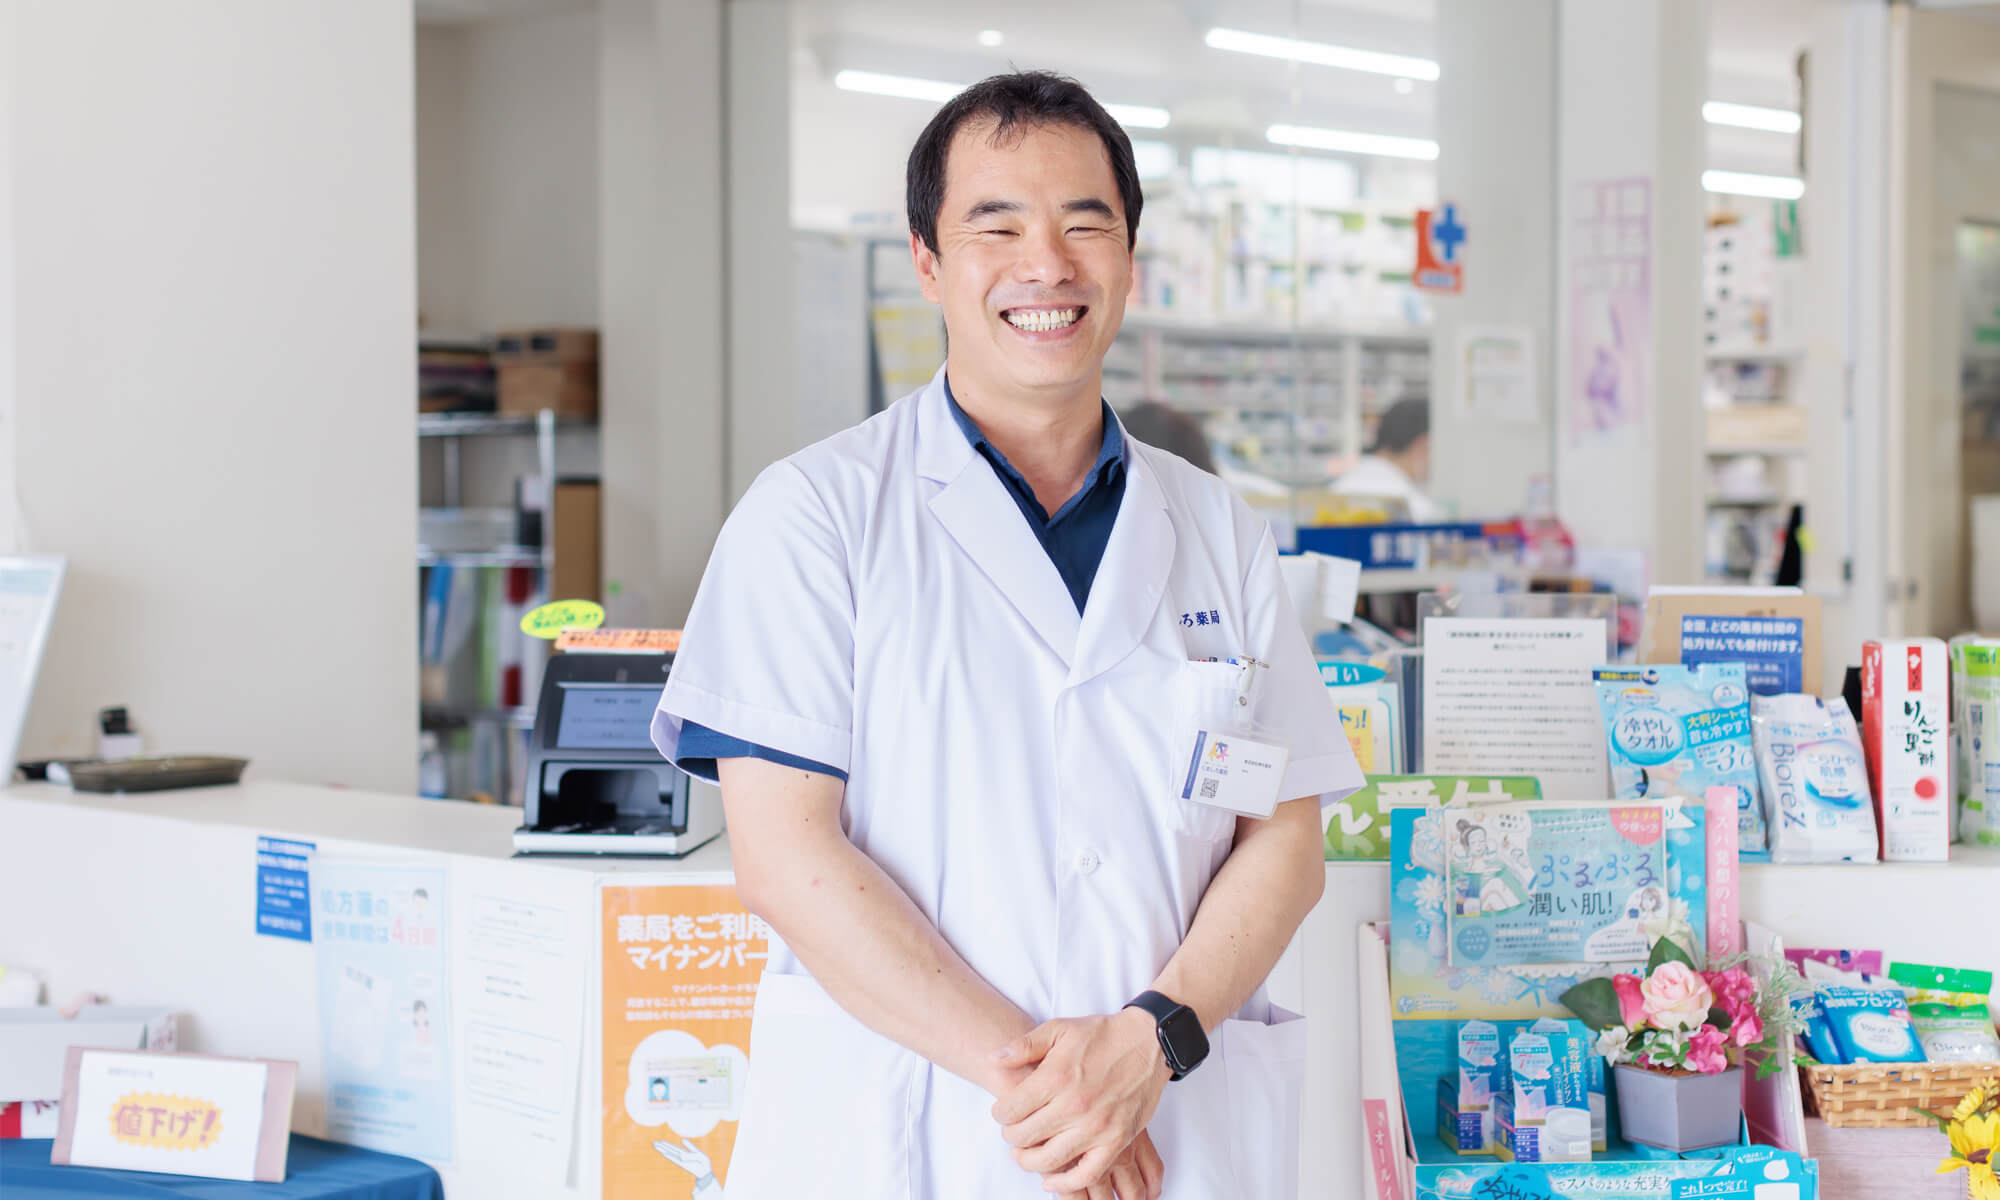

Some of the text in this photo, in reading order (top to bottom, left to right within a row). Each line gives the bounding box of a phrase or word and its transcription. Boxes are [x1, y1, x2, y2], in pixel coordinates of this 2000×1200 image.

[1179, 610, 1220, 628] ろ薬局
[1624, 717, 1673, 734] 冷やし
[1627, 735, 1675, 750] タオル
[1528, 853, 1659, 890] ぷるぷる
[1528, 891, 1613, 917] 潤い肌!
[617, 912, 769, 942] 薬局をご利用
[626, 942, 769, 971] マイナンバー
[115, 1103, 217, 1143] 値下げ!
